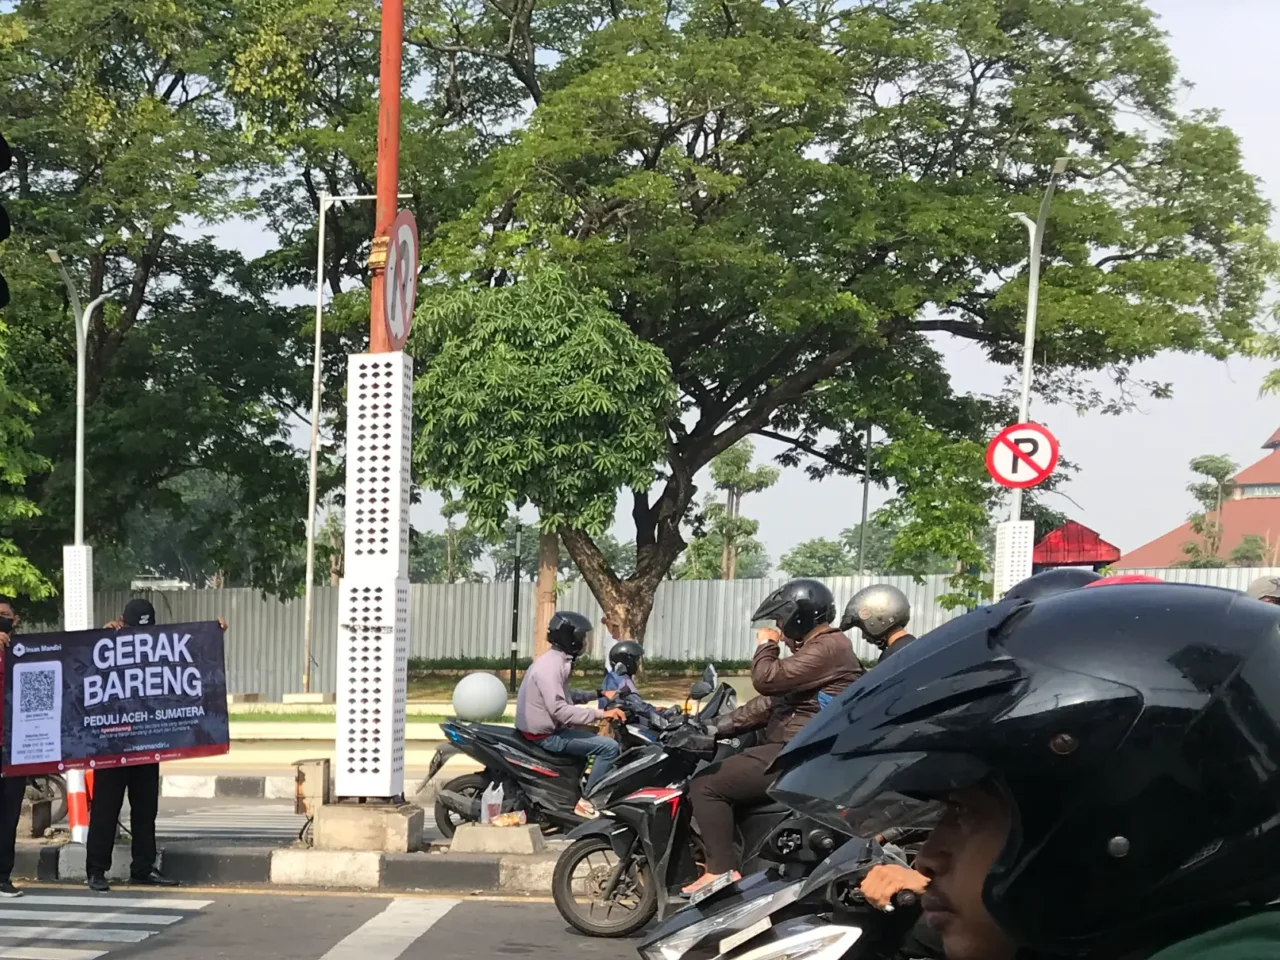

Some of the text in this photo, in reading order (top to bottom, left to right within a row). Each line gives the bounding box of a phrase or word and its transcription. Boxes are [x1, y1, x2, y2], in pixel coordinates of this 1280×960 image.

[1011, 437, 1039, 475] P
[93, 633, 193, 669] GERAK
[83, 666, 203, 707] BARENG
[83, 713, 119, 727] PEDULI
[121, 711, 148, 724] ACEH
[155, 706, 205, 720] SUMATERA
